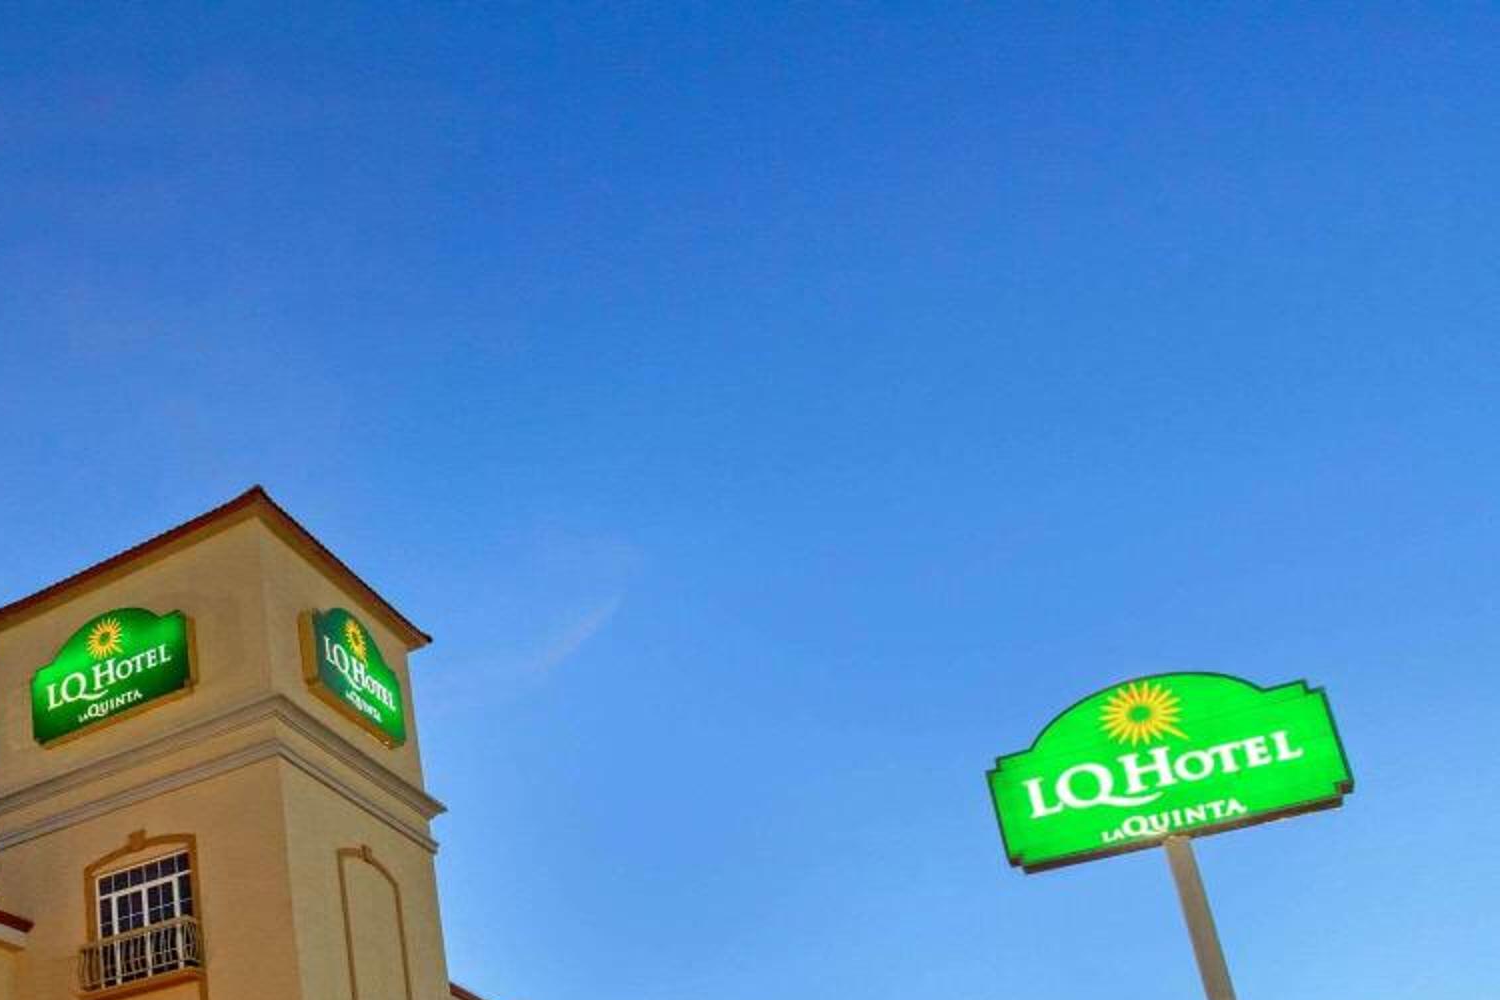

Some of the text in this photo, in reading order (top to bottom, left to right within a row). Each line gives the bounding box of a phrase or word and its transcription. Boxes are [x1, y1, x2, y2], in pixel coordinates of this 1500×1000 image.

[46, 644, 171, 711] LQ HOTEL
[1023, 731, 1303, 818] LQ HOTEL
